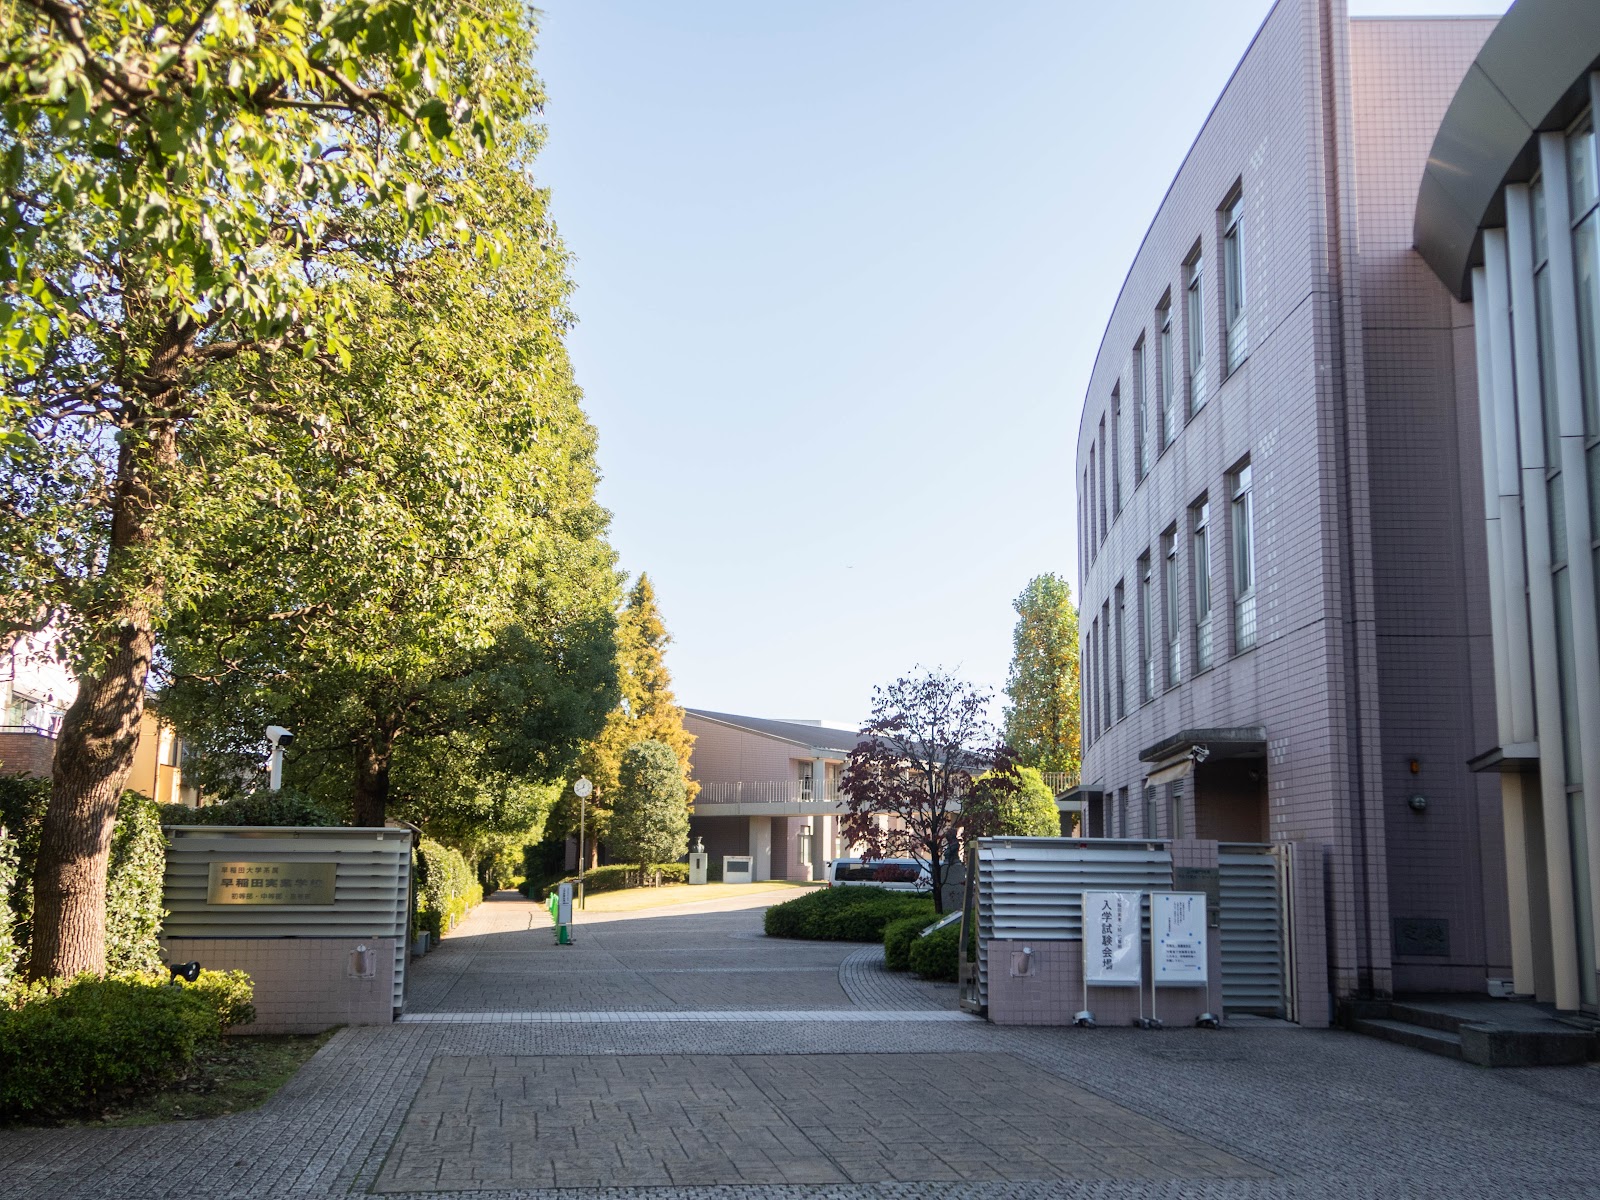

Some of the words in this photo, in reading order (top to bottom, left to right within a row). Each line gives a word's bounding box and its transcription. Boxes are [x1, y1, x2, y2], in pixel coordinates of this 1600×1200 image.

[1101, 900, 1113, 970] 入学試験会場
